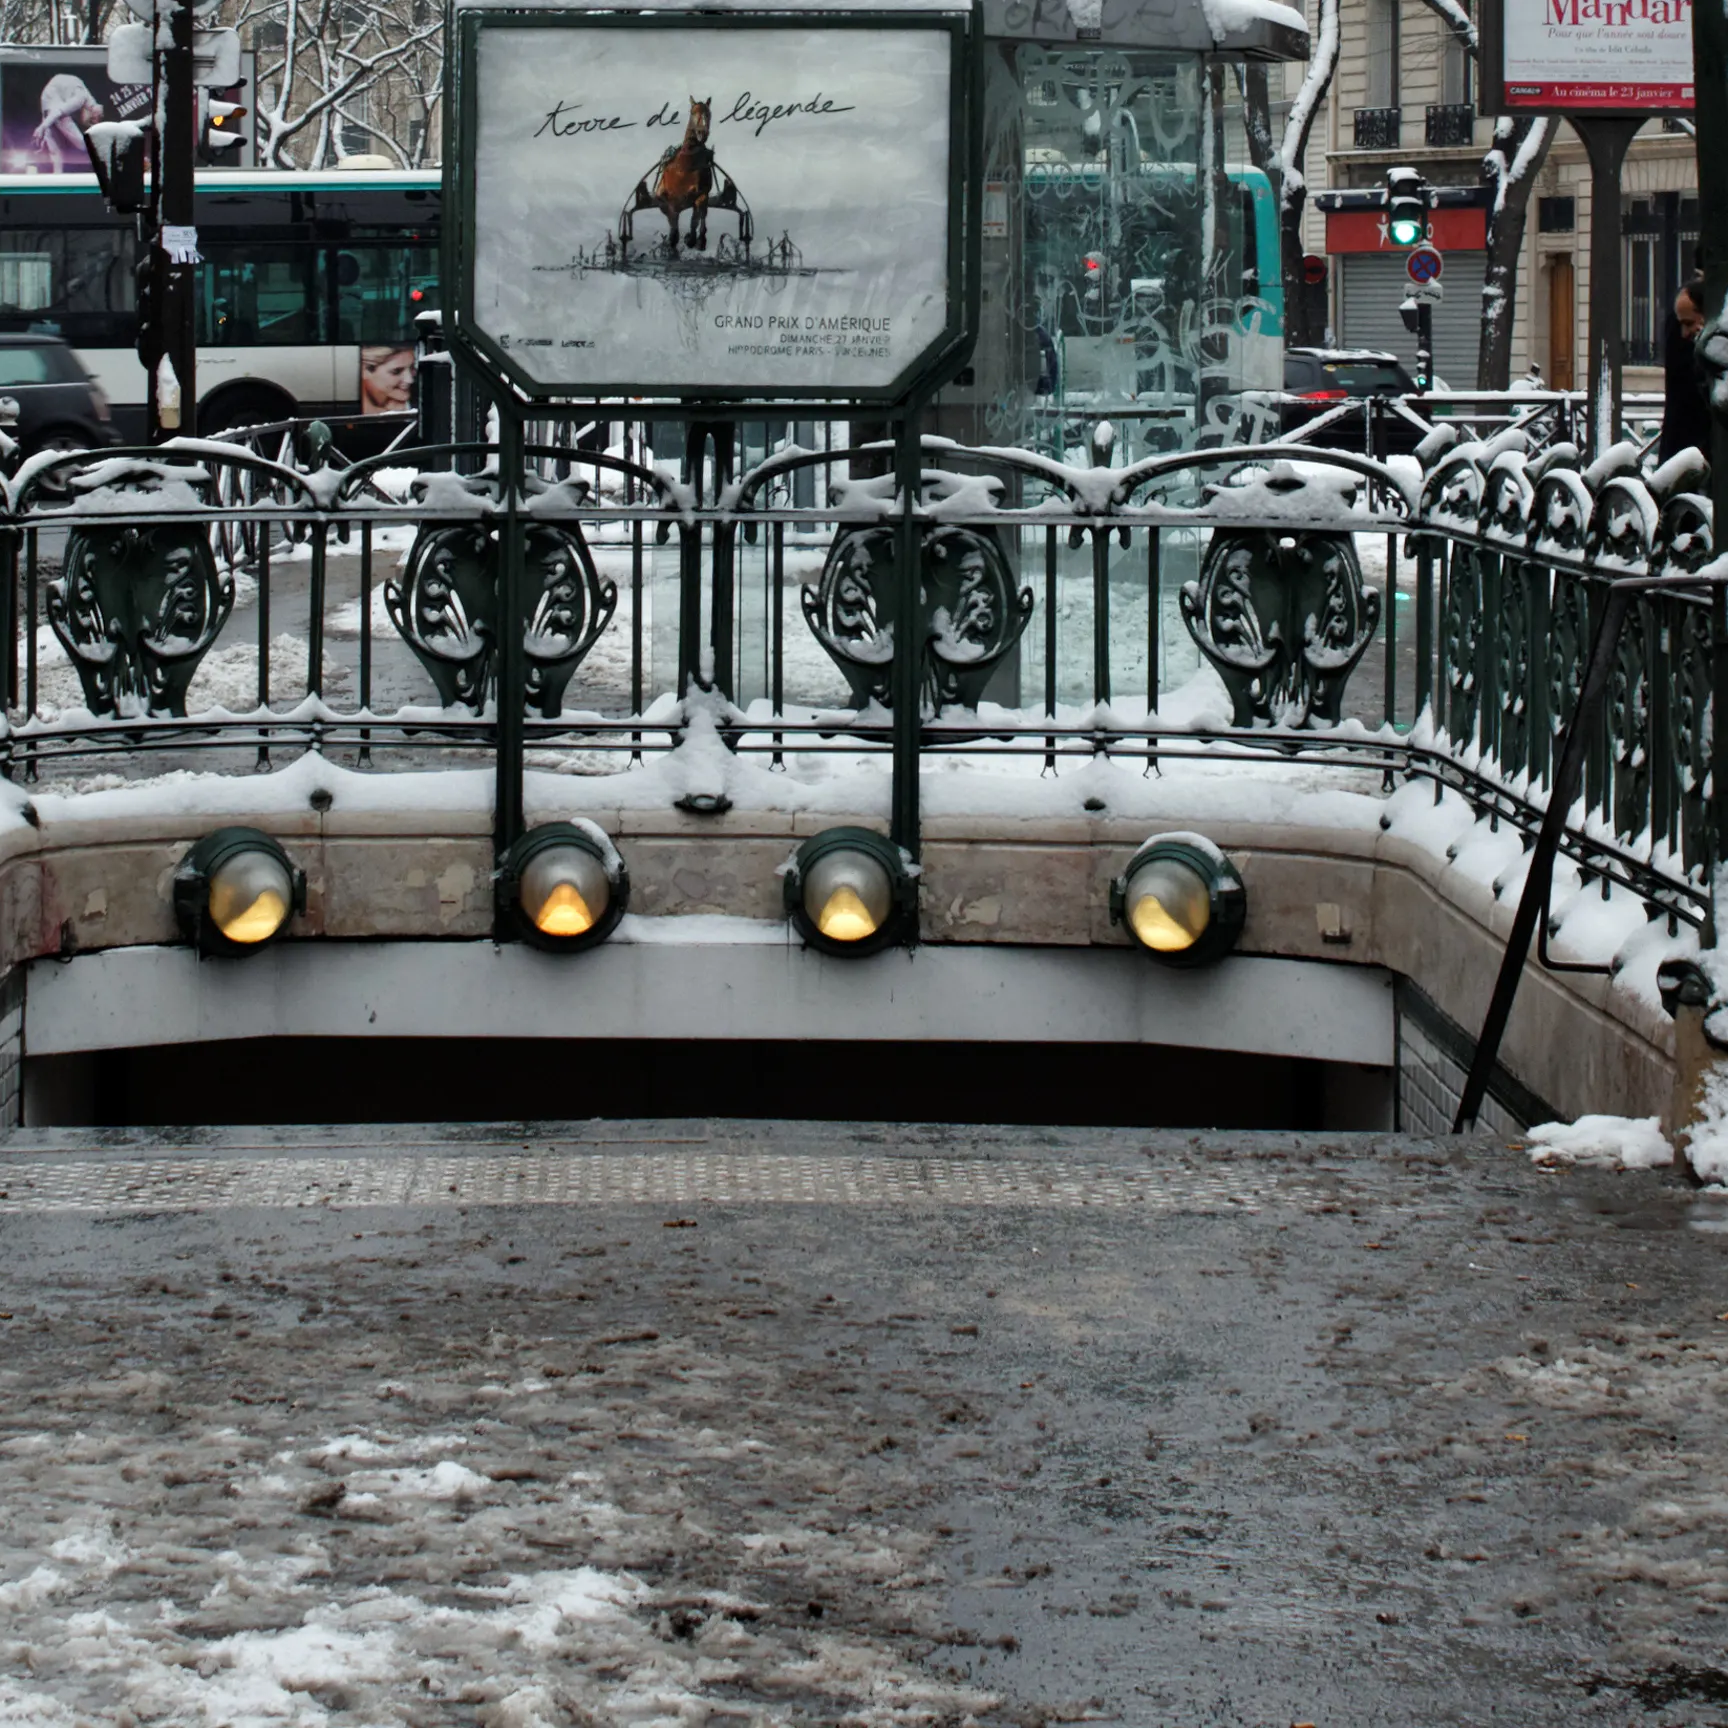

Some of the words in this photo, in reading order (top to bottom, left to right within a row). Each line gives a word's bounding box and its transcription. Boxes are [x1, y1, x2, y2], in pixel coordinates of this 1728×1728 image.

[1548, 27, 1572, 39] Pour
[1576, 30, 1592, 40] que
[1597, 28, 1632, 39] l'année
[1637, 29, 1654, 39] soit
[1657, 28, 1686, 39] douce
[1551, 86, 1567, 97] Au
[1569, 86, 1607, 97] cinéma
[1609, 86, 1618, 97] le
[1621, 87, 1633, 97] 23
[1635, 87, 1674, 100] janvier
[116, 92, 150, 118] JANVIER
[533, 100, 637, 137] terre
[646, 102, 681, 127] de
[719, 92, 855, 137] légende
[714, 315, 763, 329] GRAND
[768, 315, 799, 329] PRIX
[805, 315, 891, 332] D'AMÉRIQUE
[780, 334, 833, 344] DIMANCHE
[835, 334, 847, 344] 27
[795, 345, 824, 357] PARIS
